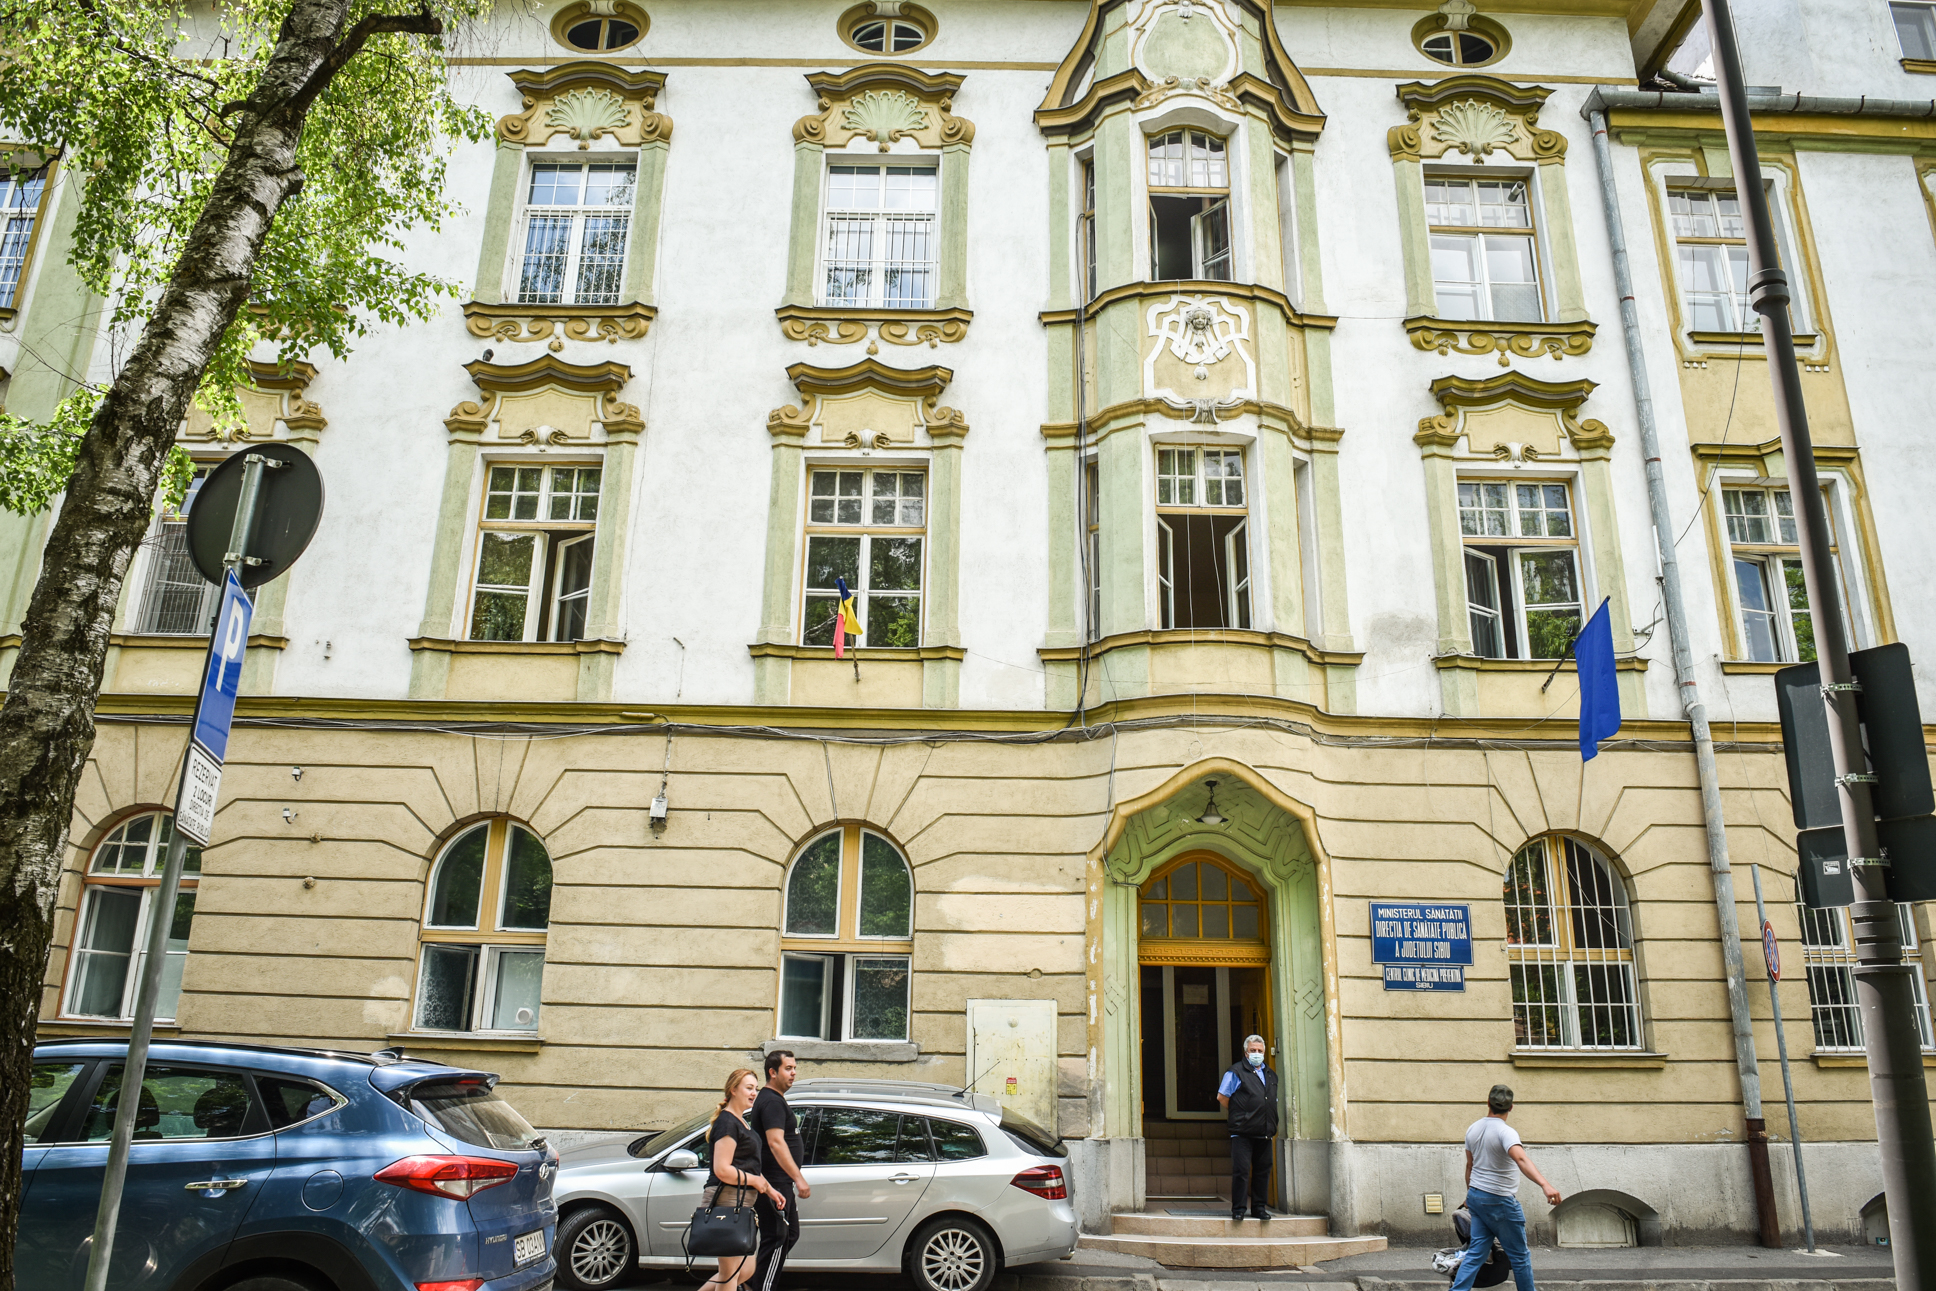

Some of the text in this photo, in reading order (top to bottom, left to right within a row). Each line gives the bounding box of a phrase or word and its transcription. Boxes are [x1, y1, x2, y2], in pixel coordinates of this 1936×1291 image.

[216, 597, 243, 692] P
[191, 758, 217, 791] REZERVAT
[193, 785, 213, 807] 2 LOCURI
[204, 809, 210, 822] DE
[1377, 908, 1463, 920] MINISTERUL SĂNĂTĂȚII
[1375, 920, 1467, 939] DIRECȚIA DE SĂNĂTATE PUBLICĂ
[1395, 940, 1450, 959] A JUDEȚULUI SIBIU
[1415, 968, 1421, 982] DE
[515, 1239, 526, 1259] SB
